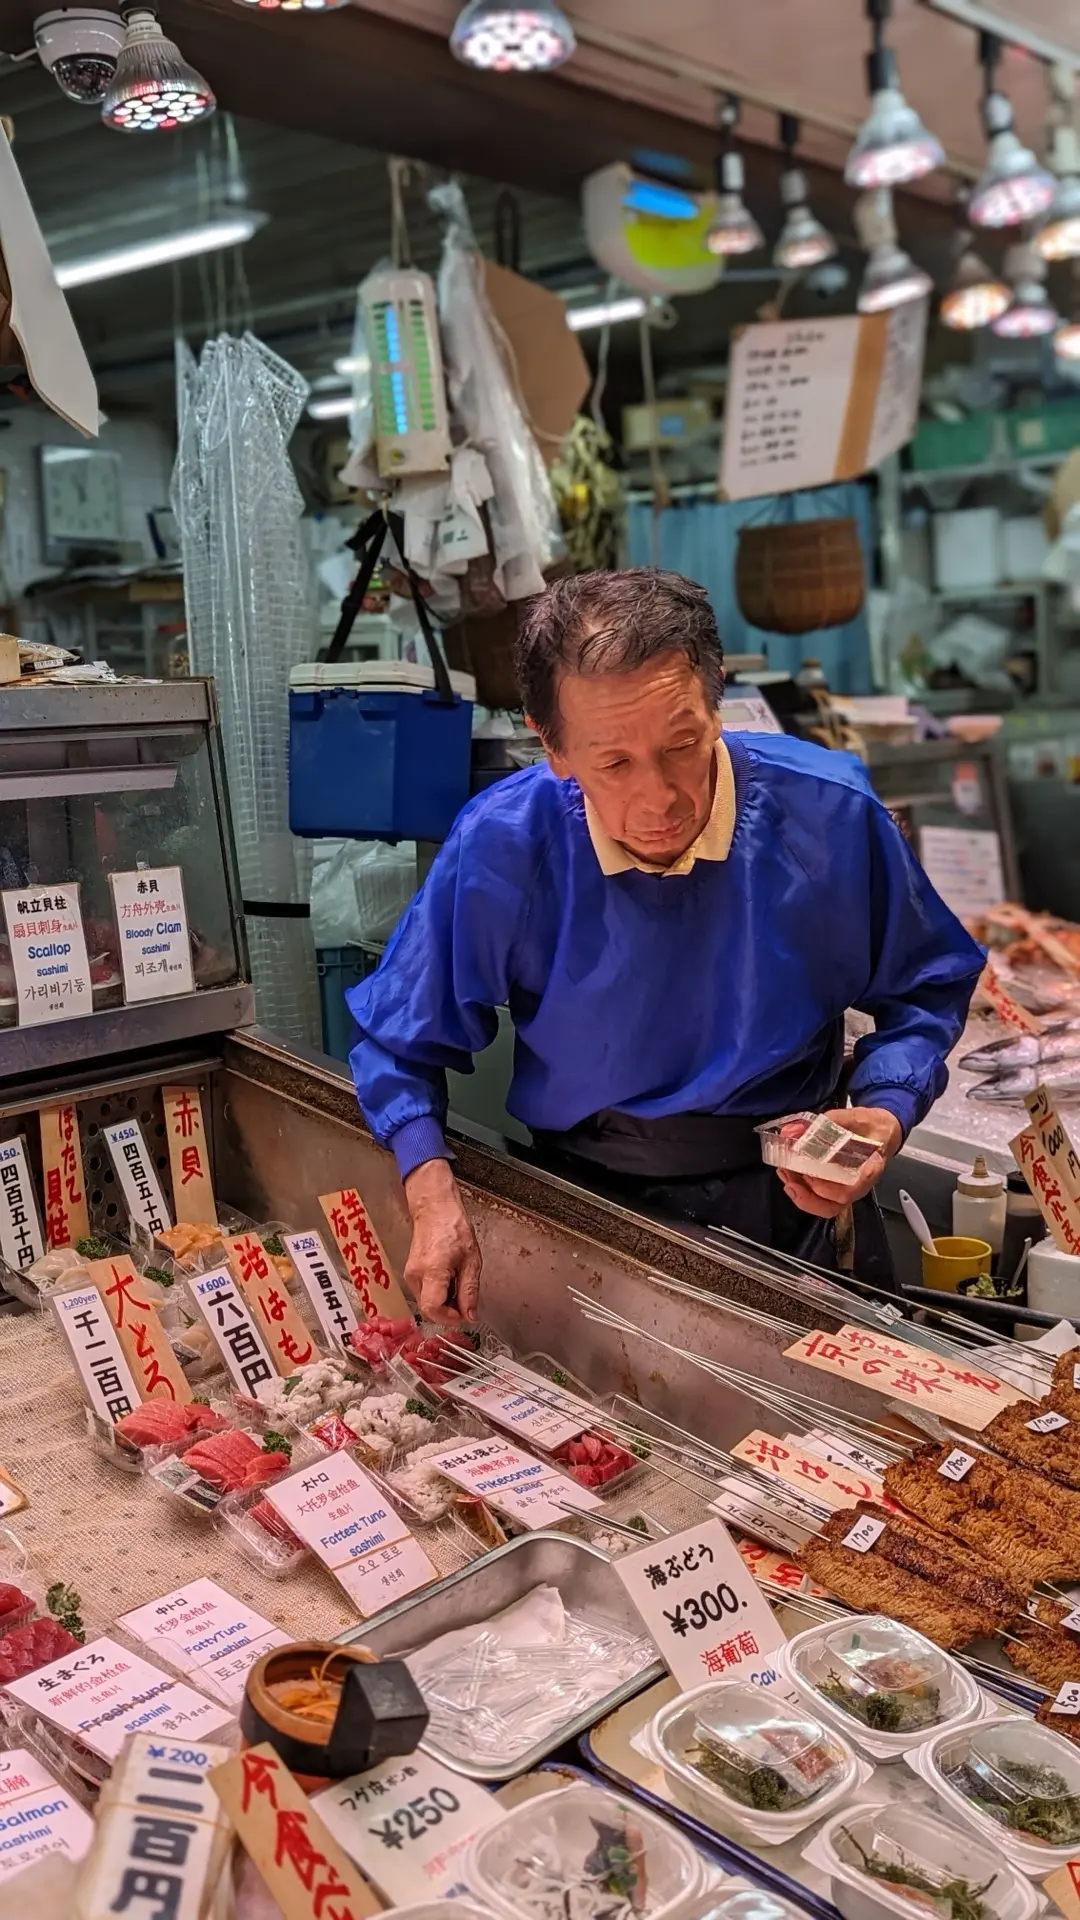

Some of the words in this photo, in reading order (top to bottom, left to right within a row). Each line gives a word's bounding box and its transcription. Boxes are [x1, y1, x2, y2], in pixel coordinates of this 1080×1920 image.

[137, 880, 159, 894] 赤貝
[17, 896, 67, 915] 帆立貝柱
[126, 929, 154, 939] Bloody
[156, 922, 182, 935] Clam
[28, 943, 71, 960] Scallop
[141, 942, 171, 955] sashimi
[37, 963, 69, 977] sashimi
[24, 978, 86, 1001] 가리비기둥
[172, 1091, 204, 1186] 赤貝
[122, 1142, 164, 1236] 四百五十円
[0, 1163, 36, 1268] 四百五十円
[197, 1275, 231, 1295] ¥600.
[61, 1292, 99, 1310] 1,200yen
[105, 1265, 176, 1400] 大とろ
[207, 1291, 273, 1398] 六百円
[74, 1310, 132, 1423] 千二百円
[802, 1333, 953, 1395] 京の味
[301, 1471, 330, 1493] 大トロ
[476, 1465, 544, 1491] Pikeconger
[320, 1521, 362, 1549] Fattest
[359, 1509, 387, 1528] Tuna
[349, 1531, 386, 1557] sashimi
[357, 1558, 380, 1577] 오오
[380, 1545, 403, 1564] 토로
[643, 1543, 714, 1590] 海ぶどう
[156, 1597, 188, 1616] 中トロ
[662, 1582, 748, 1638] ¥300.
[209, 1636, 252, 1661] sashimi
[700, 1630, 760, 1677] 海葡萄
[37, 1653, 105, 1692] 生まぐろ
[77, 1703, 134, 1733] Fresh
[131, 1681, 175, 1704] tuna
[124, 1703, 172, 1732] sashimi
[148, 1744, 213, 1768] ¥200.
[368, 1786, 461, 1851] ¥250
[0, 1825, 53, 1852] ashimi
[110, 1767, 204, 1920] 二百円
